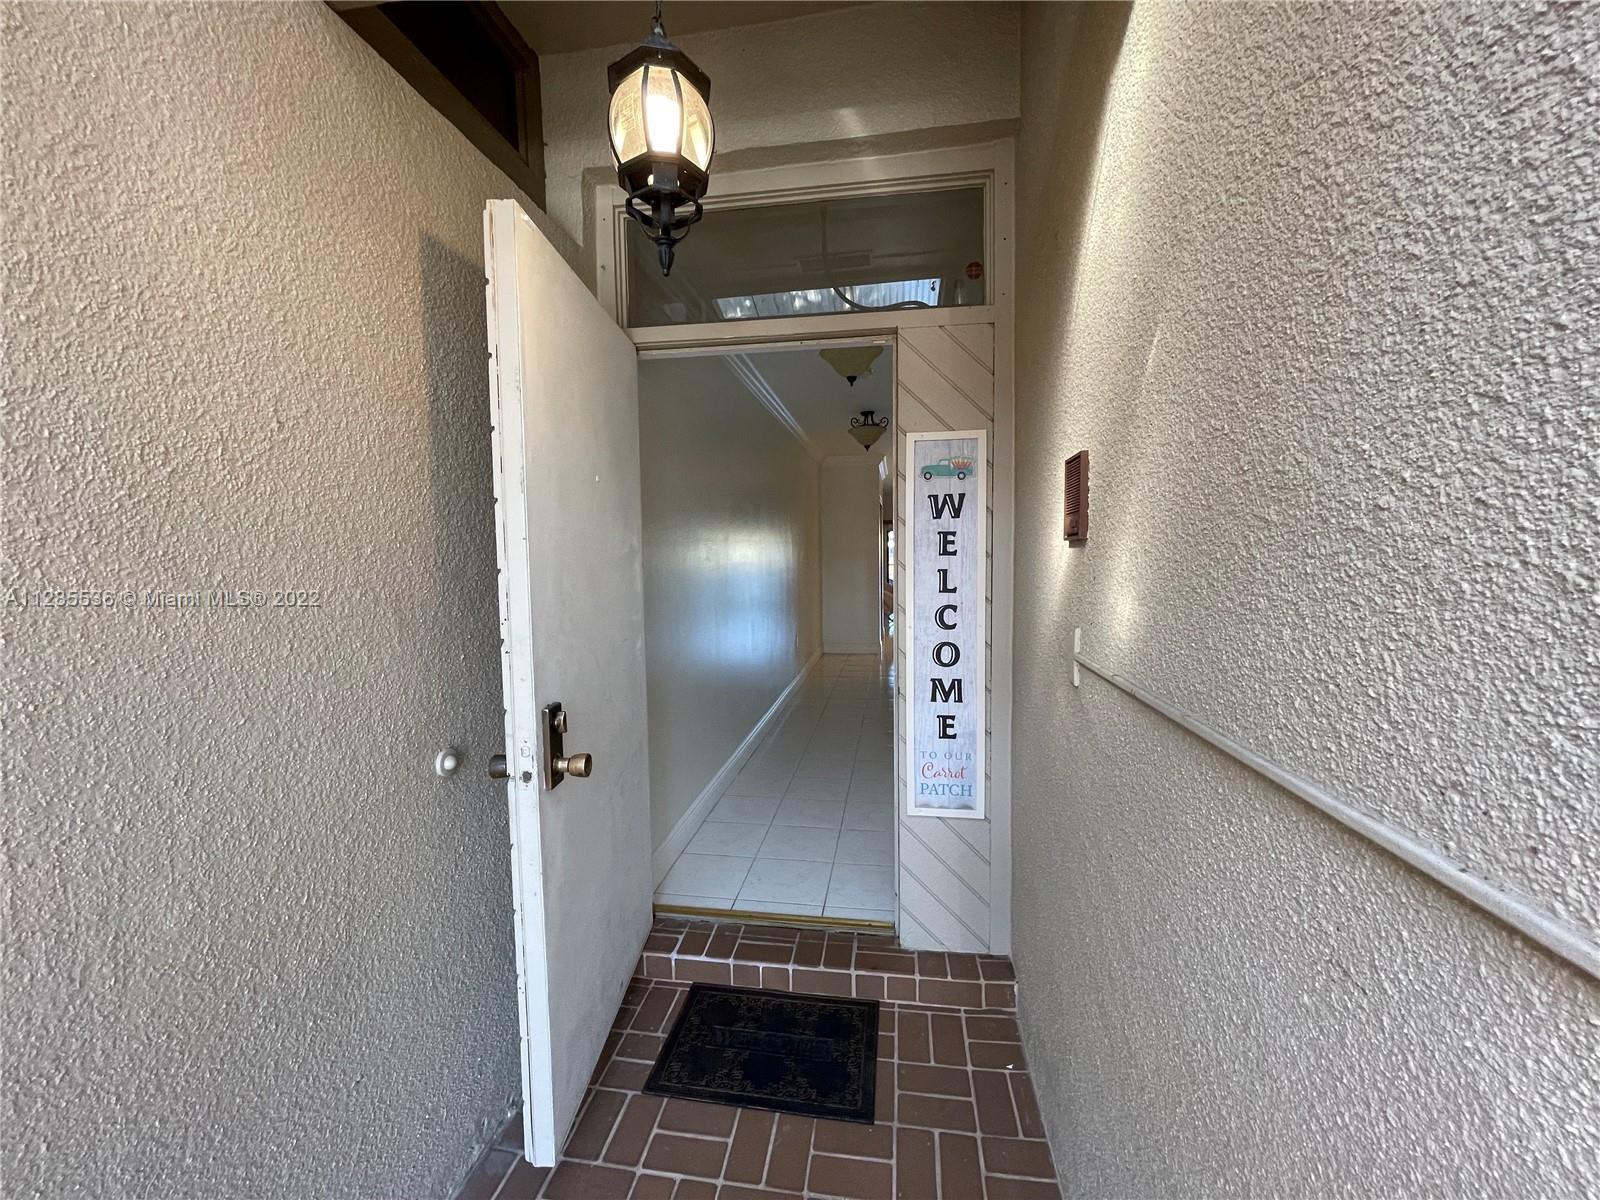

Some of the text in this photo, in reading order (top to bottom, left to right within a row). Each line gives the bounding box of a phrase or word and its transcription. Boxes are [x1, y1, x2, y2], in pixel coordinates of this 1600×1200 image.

[927, 492, 966, 740] WELCOME
[920, 750, 973, 761] TO OUR
[921, 761, 968, 780] Carrot
[920, 782, 973, 797] PATCH
